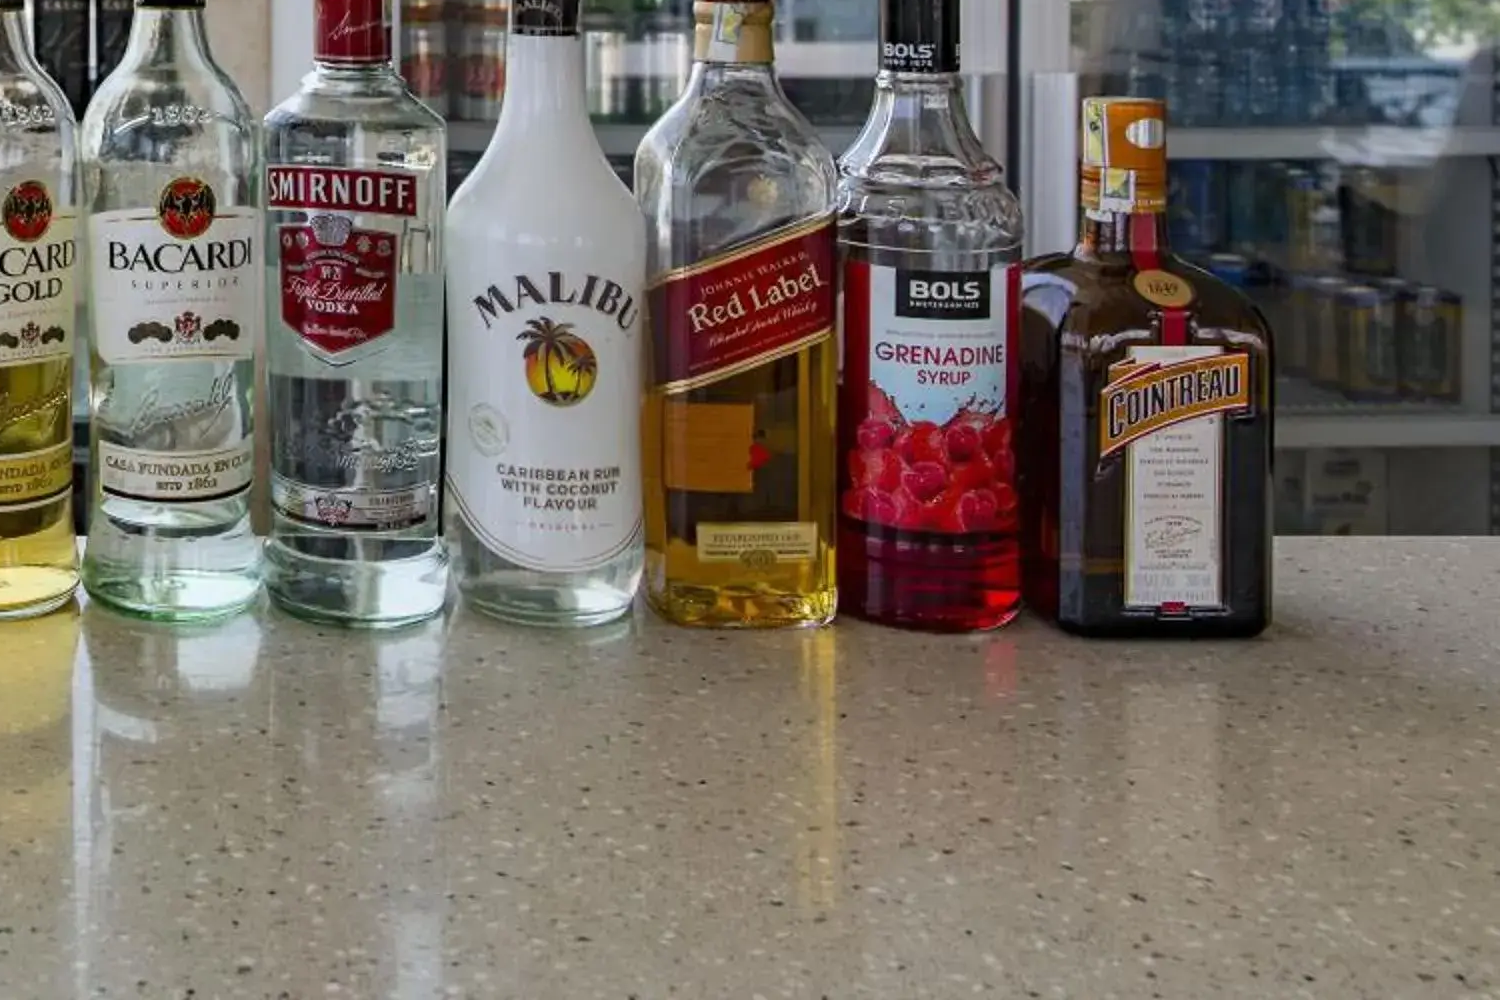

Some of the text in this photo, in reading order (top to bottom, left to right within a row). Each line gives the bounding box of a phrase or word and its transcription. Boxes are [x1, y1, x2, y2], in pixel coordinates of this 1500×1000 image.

[884, 44, 932, 59] BOLS
[269, 171, 411, 209] SMIRNOFF
[131, 276, 240, 290] SUPERIOR
[909, 279, 980, 300] BOLS
[306, 299, 360, 315] VODKA
[473, 271, 639, 331] MALIBU
[688, 263, 828, 333] Red Label
[875, 341, 1004, 366] GRENADINE
[917, 369, 971, 386] SYRUP
[1109, 366, 1240, 440] COINTREAU
[105, 455, 135, 473] CASA
[138, 461, 211, 478] FUNDADA
[496, 463, 621, 481] CARIBBEAN RUM
[501, 479, 618, 496] WITH COCONUT
[523, 497, 597, 511] FLAVOUR
